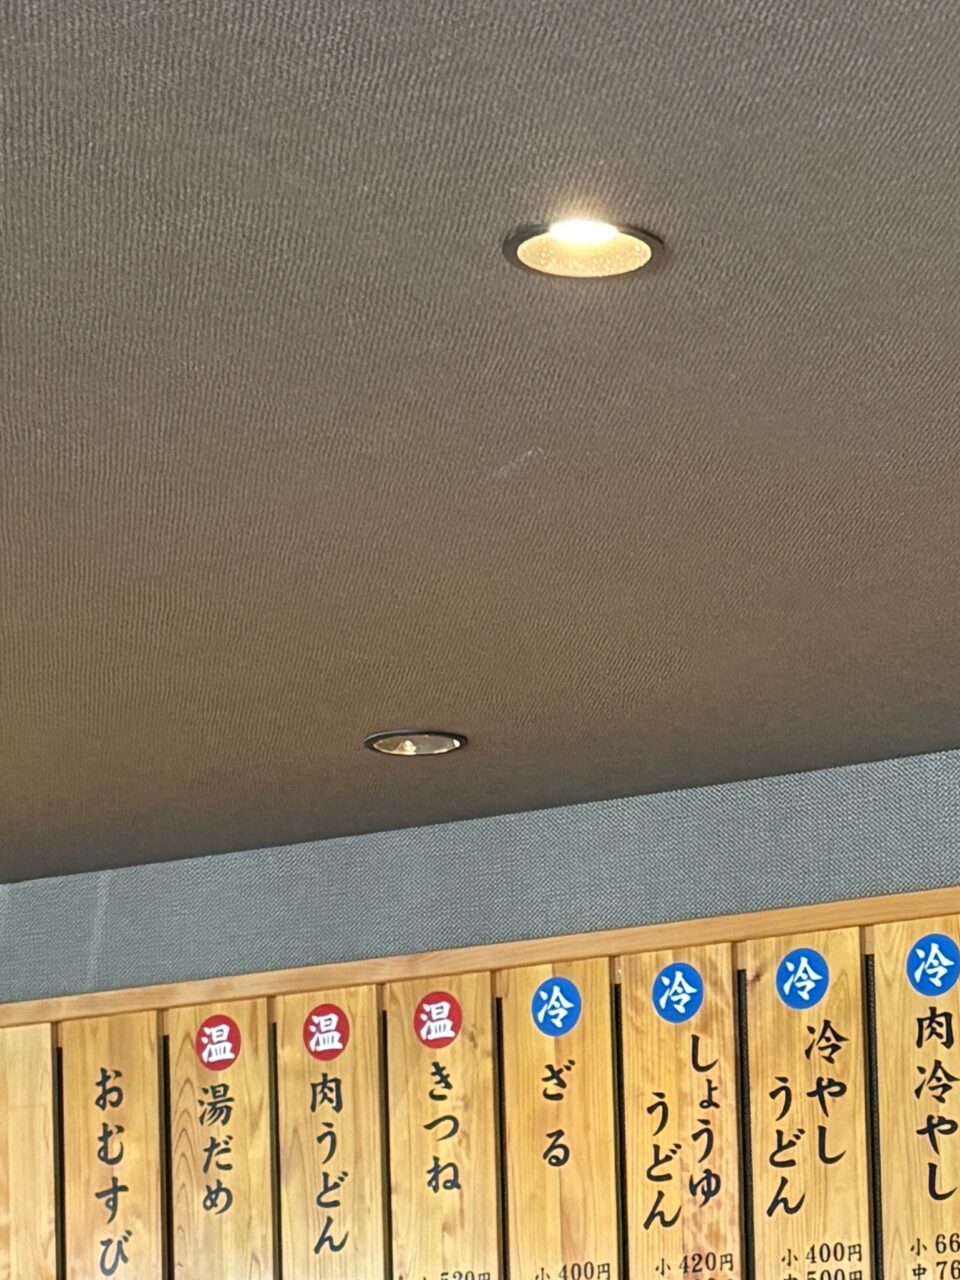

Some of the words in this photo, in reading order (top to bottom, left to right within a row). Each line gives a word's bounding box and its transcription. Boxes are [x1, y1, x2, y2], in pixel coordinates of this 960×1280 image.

[783, 956, 823, 1000] 冷
[914, 942, 955, 988] 冷
[537, 985, 575, 1028] 冷
[659, 970, 698, 1014] 冷
[308, 1012, 343, 1052] 温
[420, 1000, 456, 1040] 温
[201, 1024, 235, 1063] 温
[541, 1059, 575, 1167] ざる
[804, 1019, 850, 1164] 冷やし
[423, 1061, 461, 1193] きつね
[688, 1034, 721, 1208] しょうゆ
[197, 1083, 235, 1215] 湯だめ
[310, 1072, 348, 1254] 肉うどん
[643, 1091, 682, 1230] うどん
[766, 1076, 806, 1217] うどん
[94, 1067, 133, 1277] おむすび
[655, 1258, 671, 1277] 小
[679, 1252, 734, 1274] 420円
[781, 1248, 798, 1267] 小
[806, 1242, 863, 1264] 400円
[910, 1238, 927, 1256] 小
